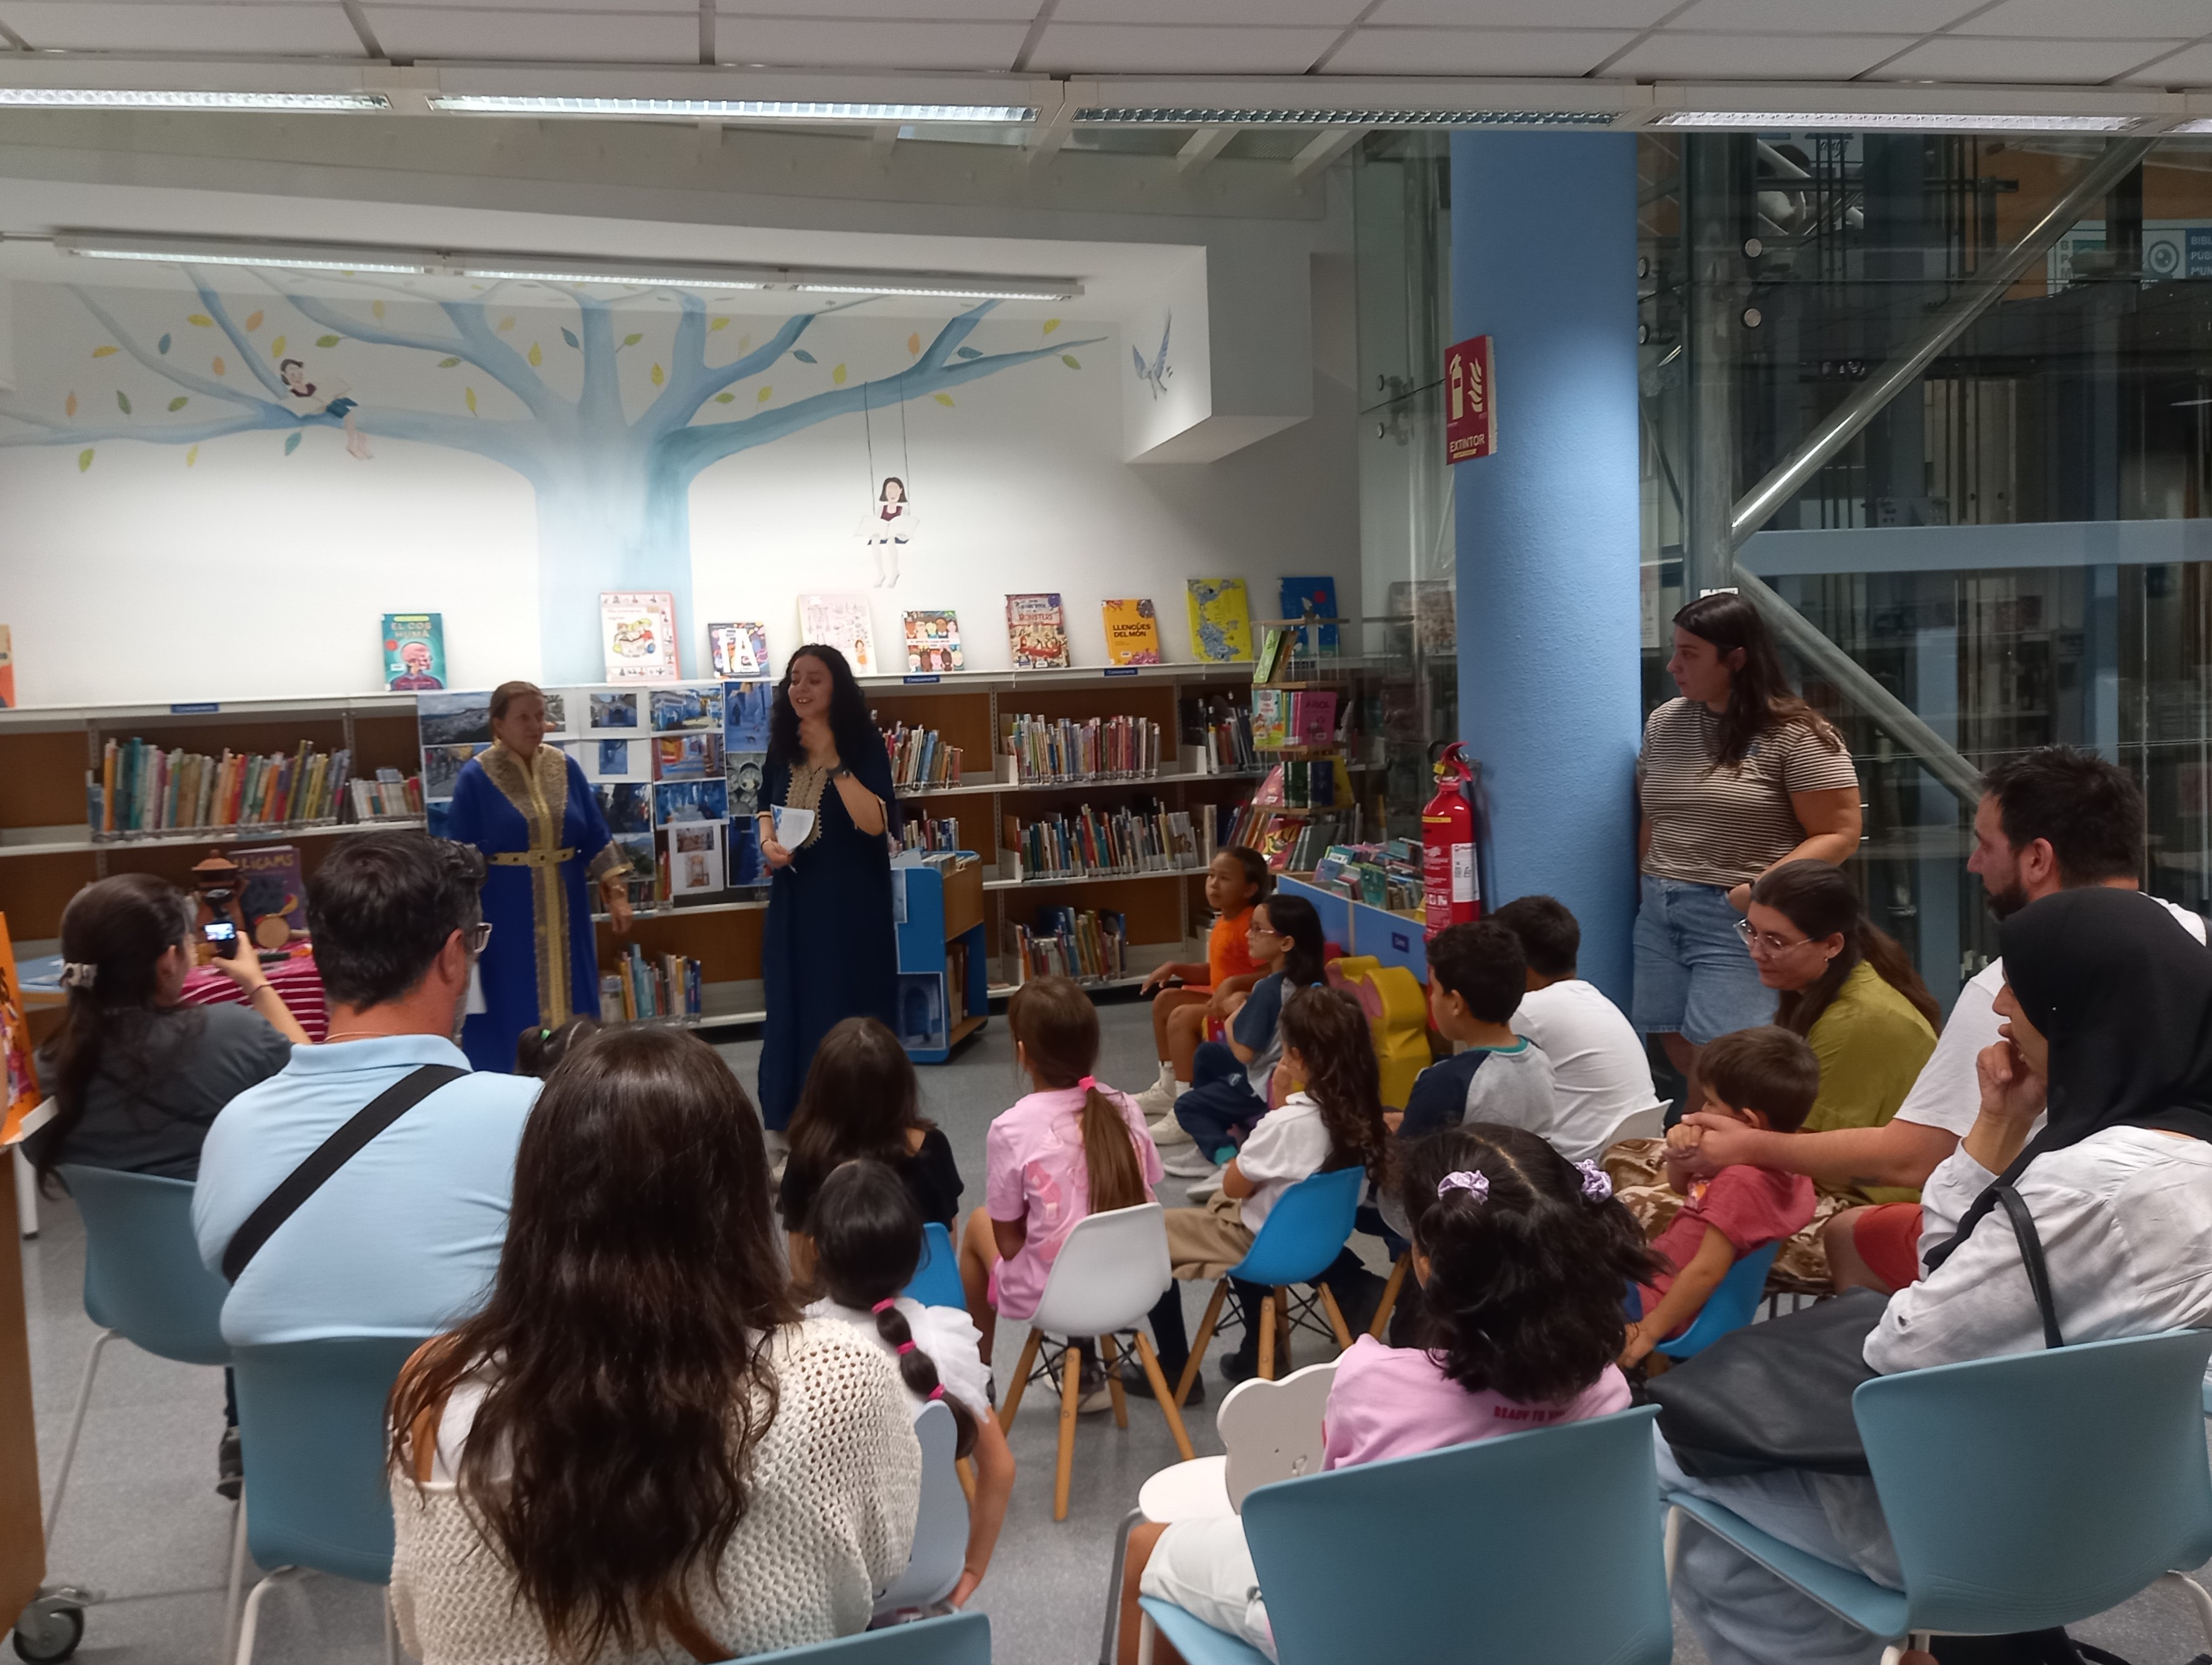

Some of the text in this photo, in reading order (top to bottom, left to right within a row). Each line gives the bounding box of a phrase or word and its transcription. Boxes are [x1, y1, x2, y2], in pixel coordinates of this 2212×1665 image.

[2190, 250, 2212, 260] PÚB
[1449, 433, 1486, 453] EXTINTOR
[1113, 623, 1151, 631] LLENGÜES
[1494, 1405, 1530, 1421] READY
[1533, 1410, 1545, 1422] TO
